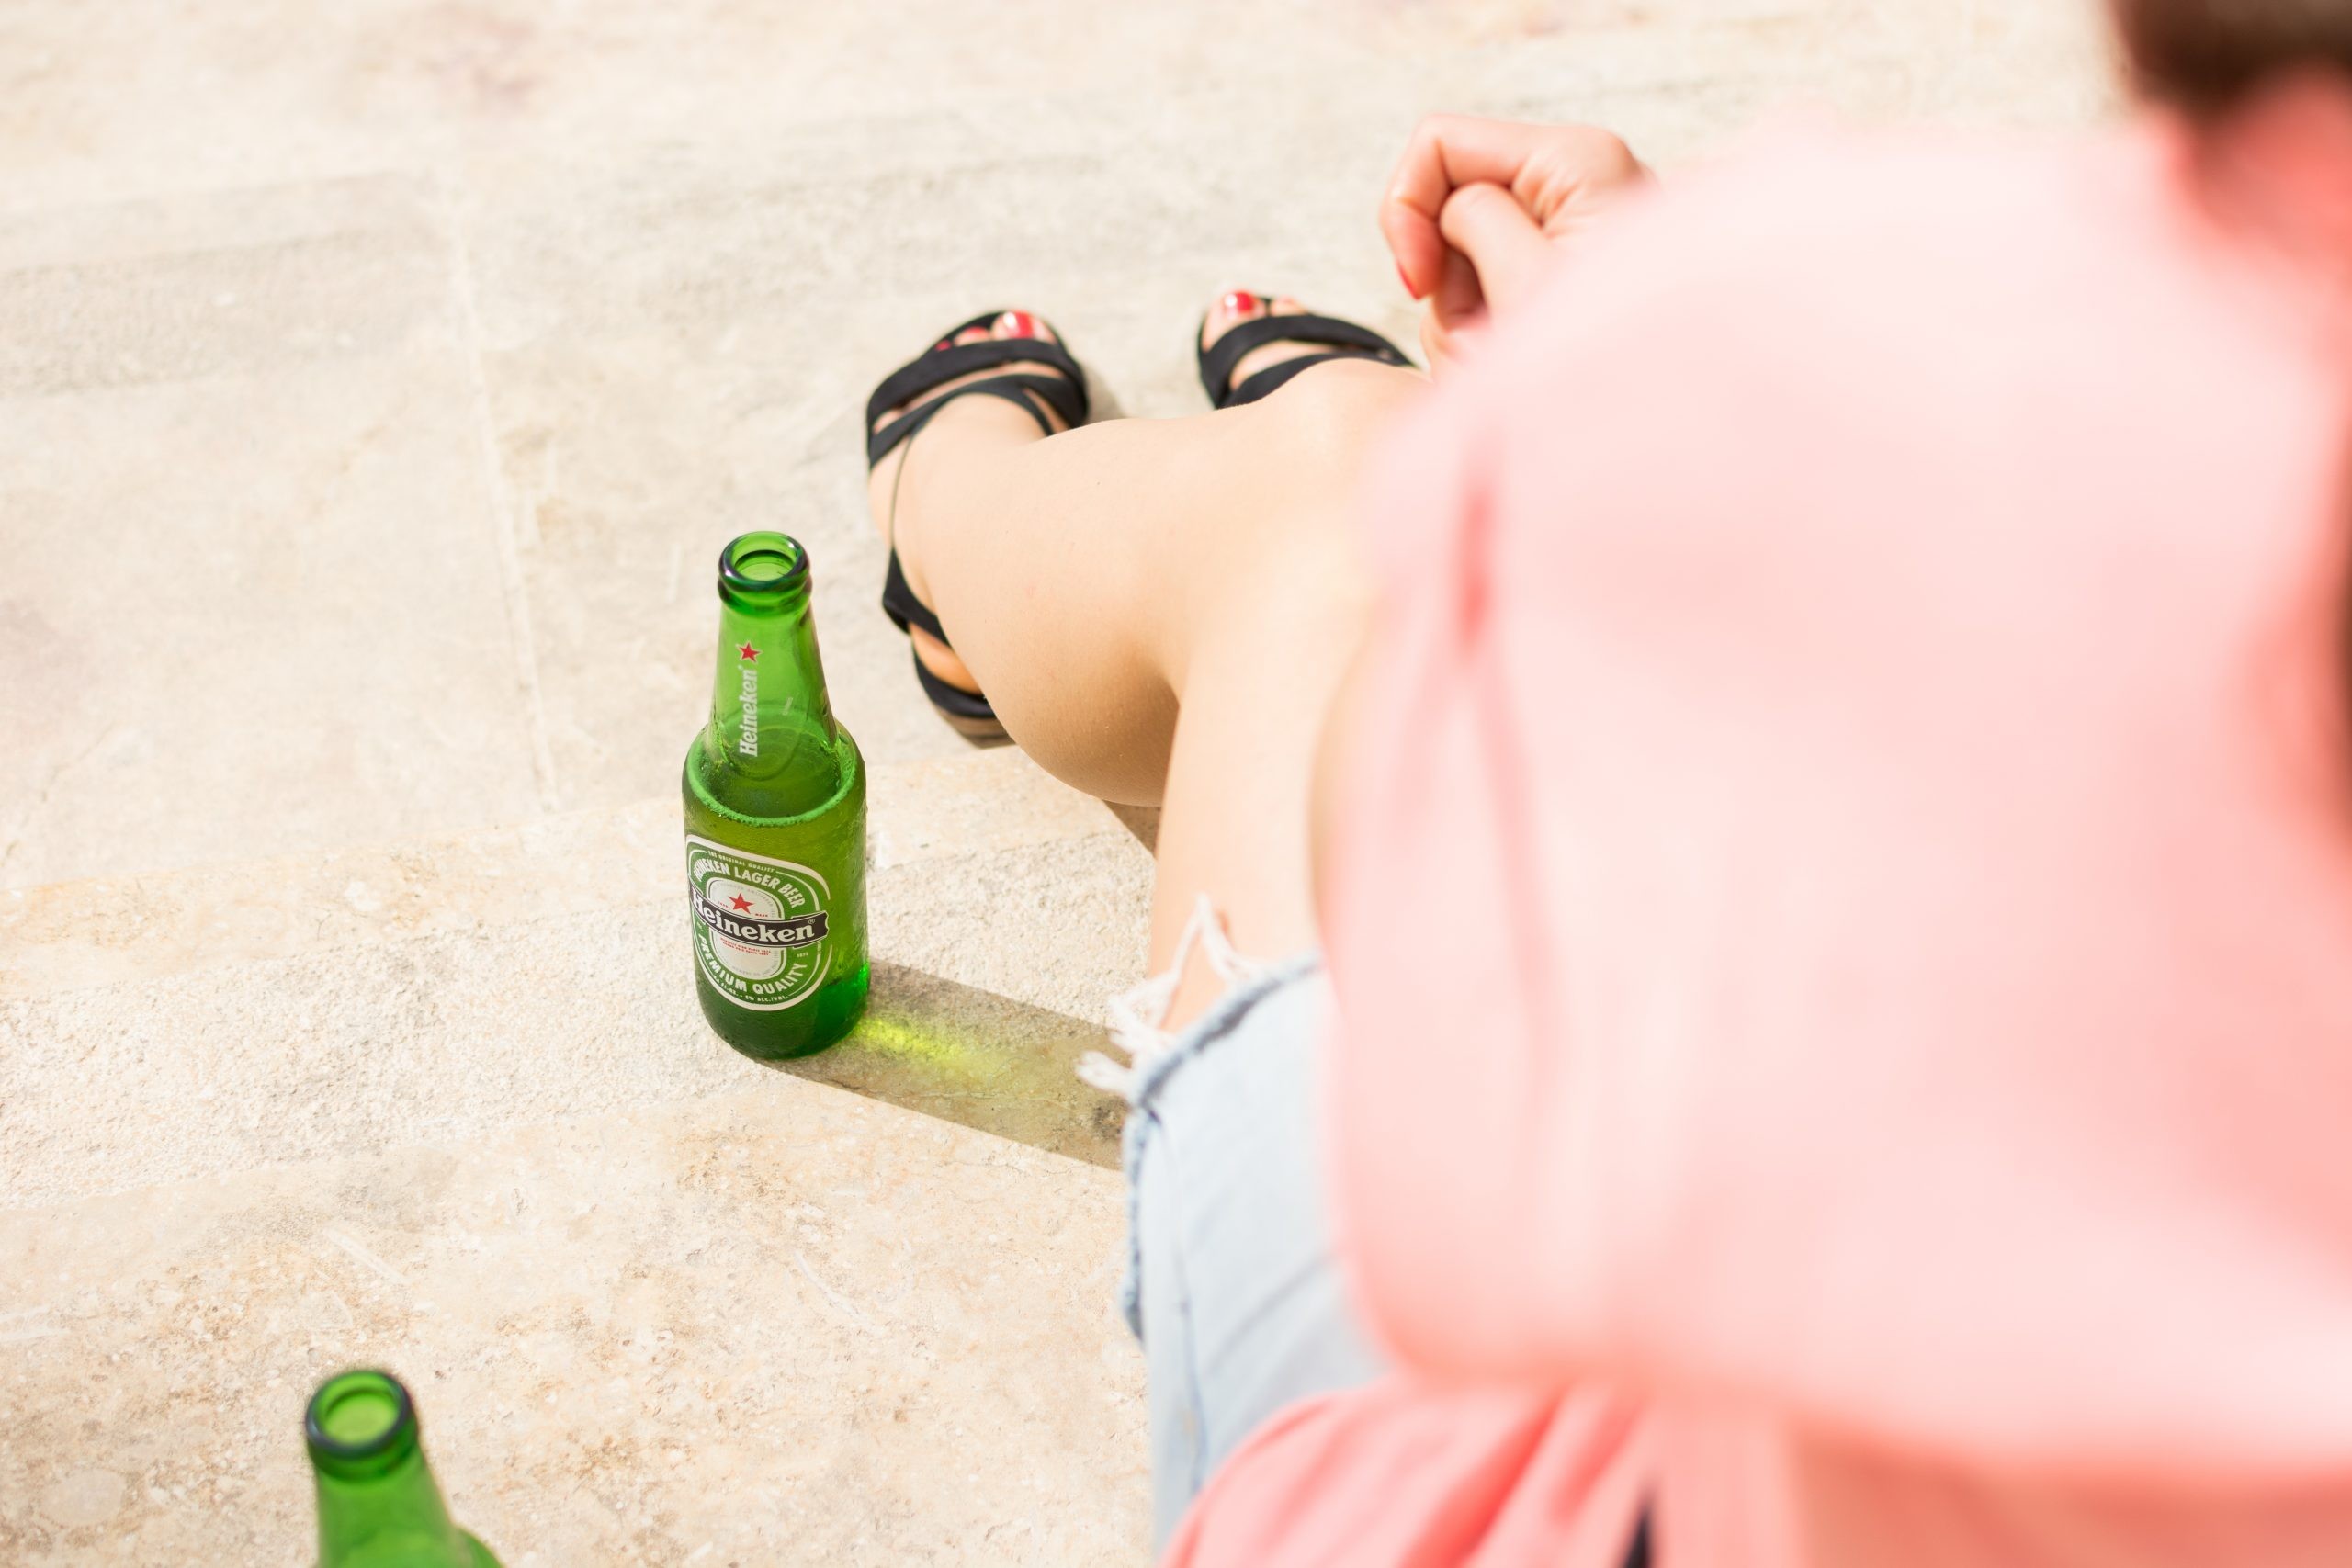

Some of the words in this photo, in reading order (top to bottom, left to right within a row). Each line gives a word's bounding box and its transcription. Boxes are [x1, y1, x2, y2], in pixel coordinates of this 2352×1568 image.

[739, 669, 758, 757] Heineken
[734, 866, 780, 889] LAGER
[778, 883, 806, 908] BEER
[748, 863, 775, 873] QUALITY
[698, 933, 748, 993] PREMIUM
[752, 963, 808, 995] QUALITY
